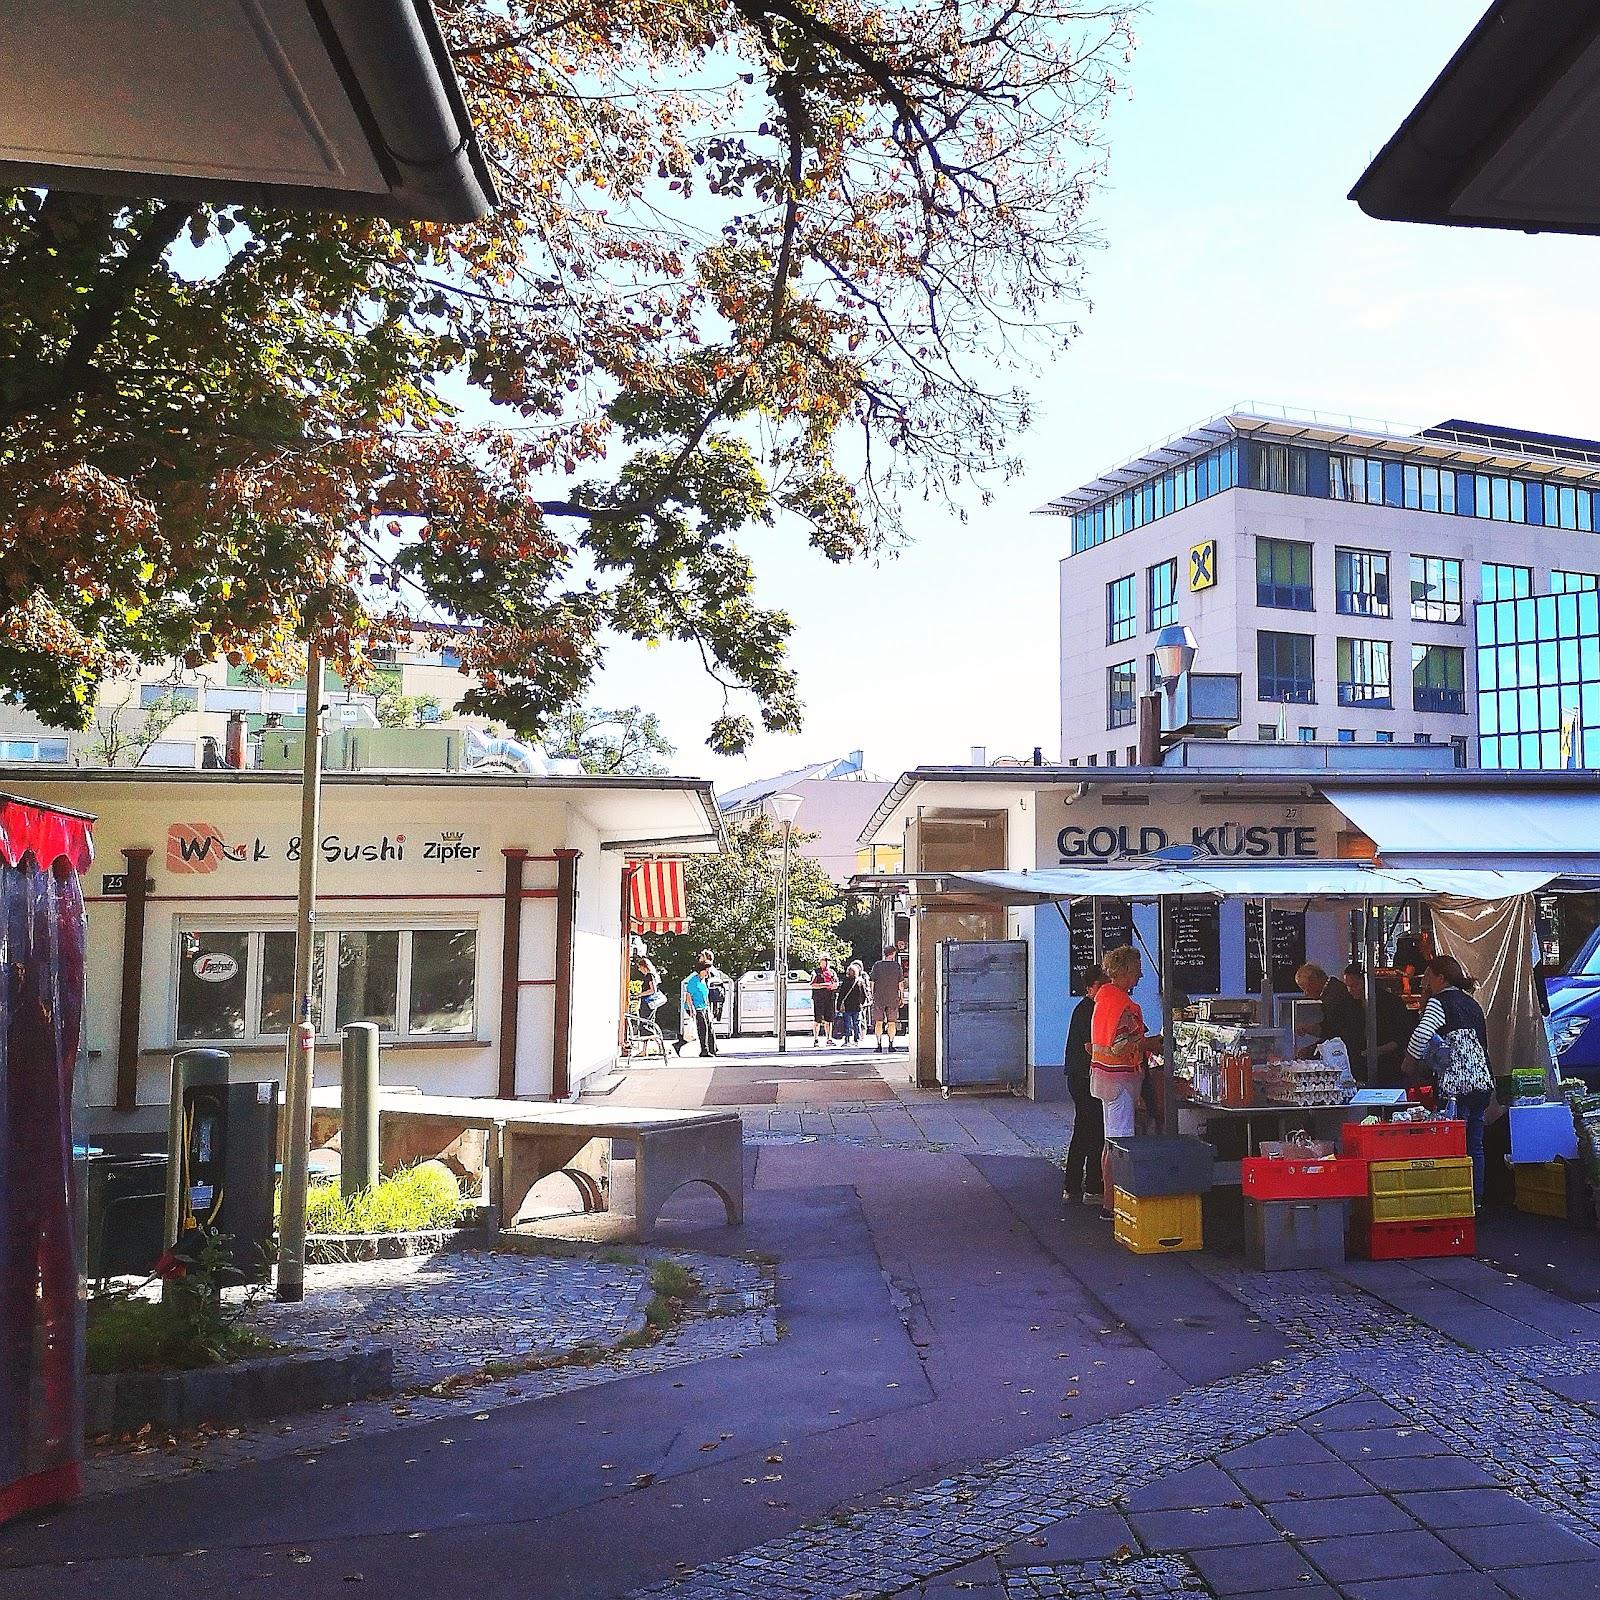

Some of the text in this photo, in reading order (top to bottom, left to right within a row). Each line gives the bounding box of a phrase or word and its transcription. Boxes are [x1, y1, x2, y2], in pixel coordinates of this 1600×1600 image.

[1285, 808, 1298, 819] 27
[320, 834, 407, 863] Sushi
[1056, 821, 1319, 857] GOLD KÜSTE
[423, 842, 481, 864] Zipfer
